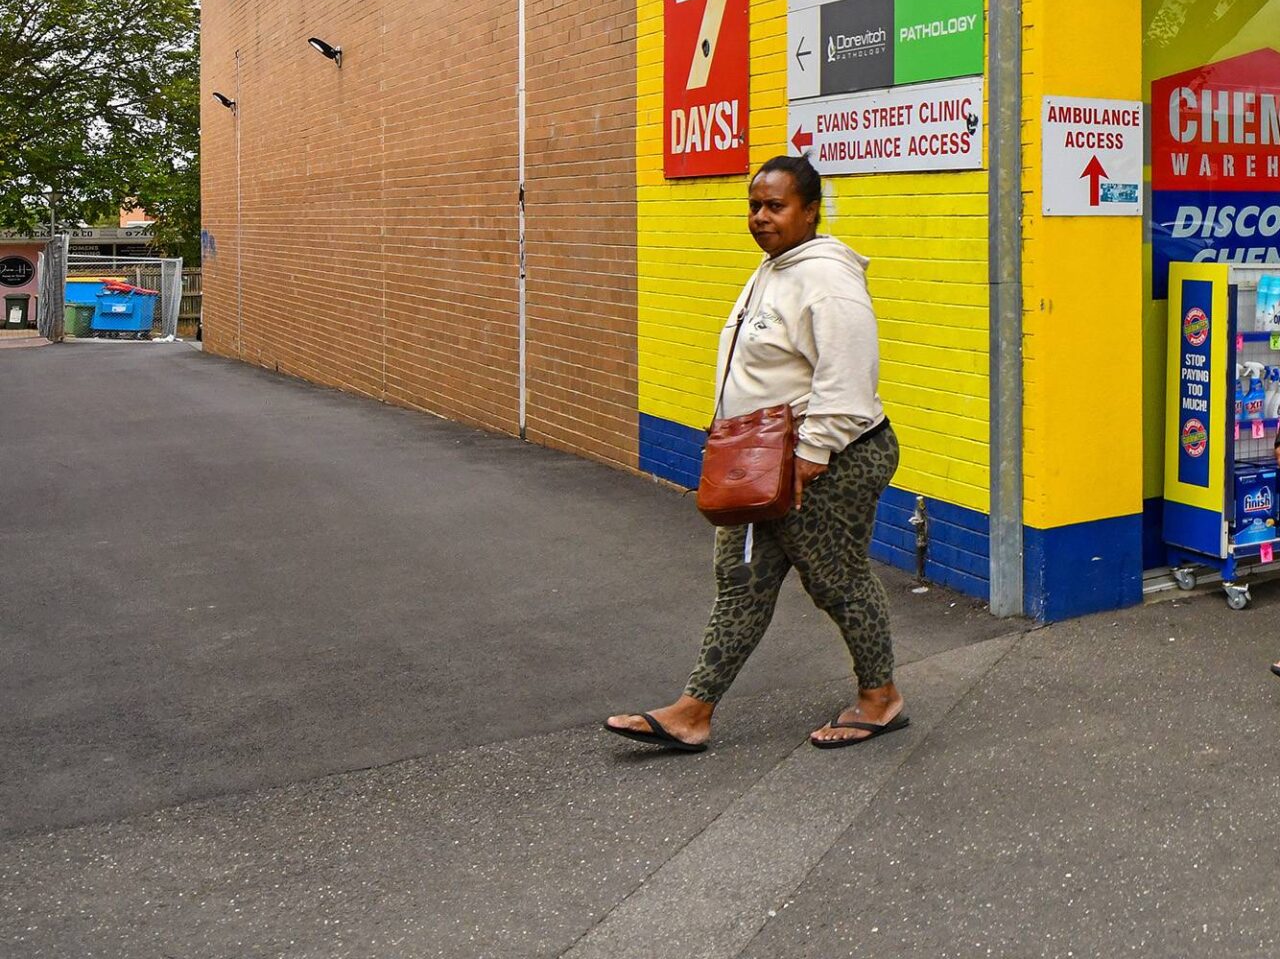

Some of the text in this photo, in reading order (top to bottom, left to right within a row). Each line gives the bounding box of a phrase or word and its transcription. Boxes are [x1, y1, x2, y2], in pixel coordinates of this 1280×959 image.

[900, 14, 977, 43] PATHOLOGY
[836, 46, 885, 60] PATHOLOGY
[817, 97, 972, 133] EVANS STREET CLINIC
[1048, 106, 1140, 126] AMBULANCE
[670, 99, 740, 155] DAYS!
[819, 131, 971, 162] AMBULANCE ACCESS
[1065, 131, 1123, 149] ACCESS
[1185, 353, 1206, 367] STOP
[1182, 367, 1209, 382] PAYING
[1187, 383, 1203, 397] TOO
[1182, 397, 1207, 412] MUCH!
[1244, 491, 1271, 510] finish
